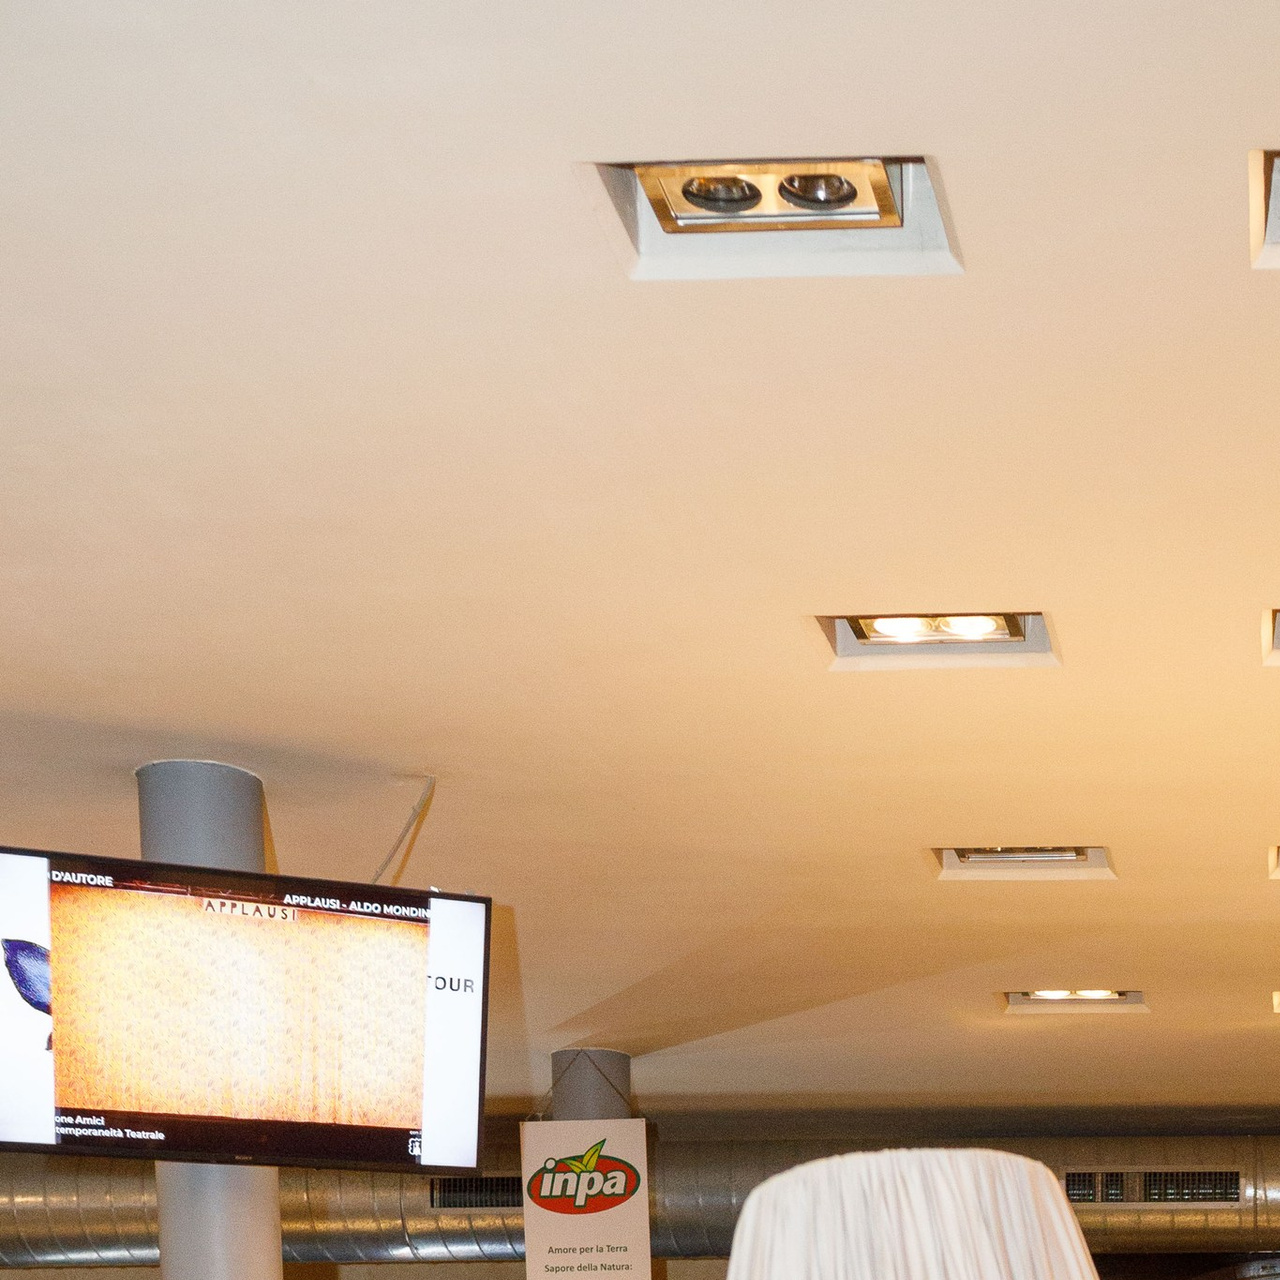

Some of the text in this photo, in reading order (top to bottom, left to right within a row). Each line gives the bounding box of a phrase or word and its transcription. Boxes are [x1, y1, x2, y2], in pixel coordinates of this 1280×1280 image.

[51, 870, 114, 887] D'AUTORE
[205, 899, 297, 921] APPLAUSI
[283, 894, 340, 909] APPLAUSI
[349, 901, 381, 913] ALDO
[427, 975, 475, 993] OUR
[75, 1115, 105, 1126] Amici
[125, 1129, 165, 1140] Teatrale
[540, 1157, 628, 1208] inpa
[547, 1244, 629, 1255] Amore per la Terra
[544, 1262, 633, 1273] Sapore della Natura:
